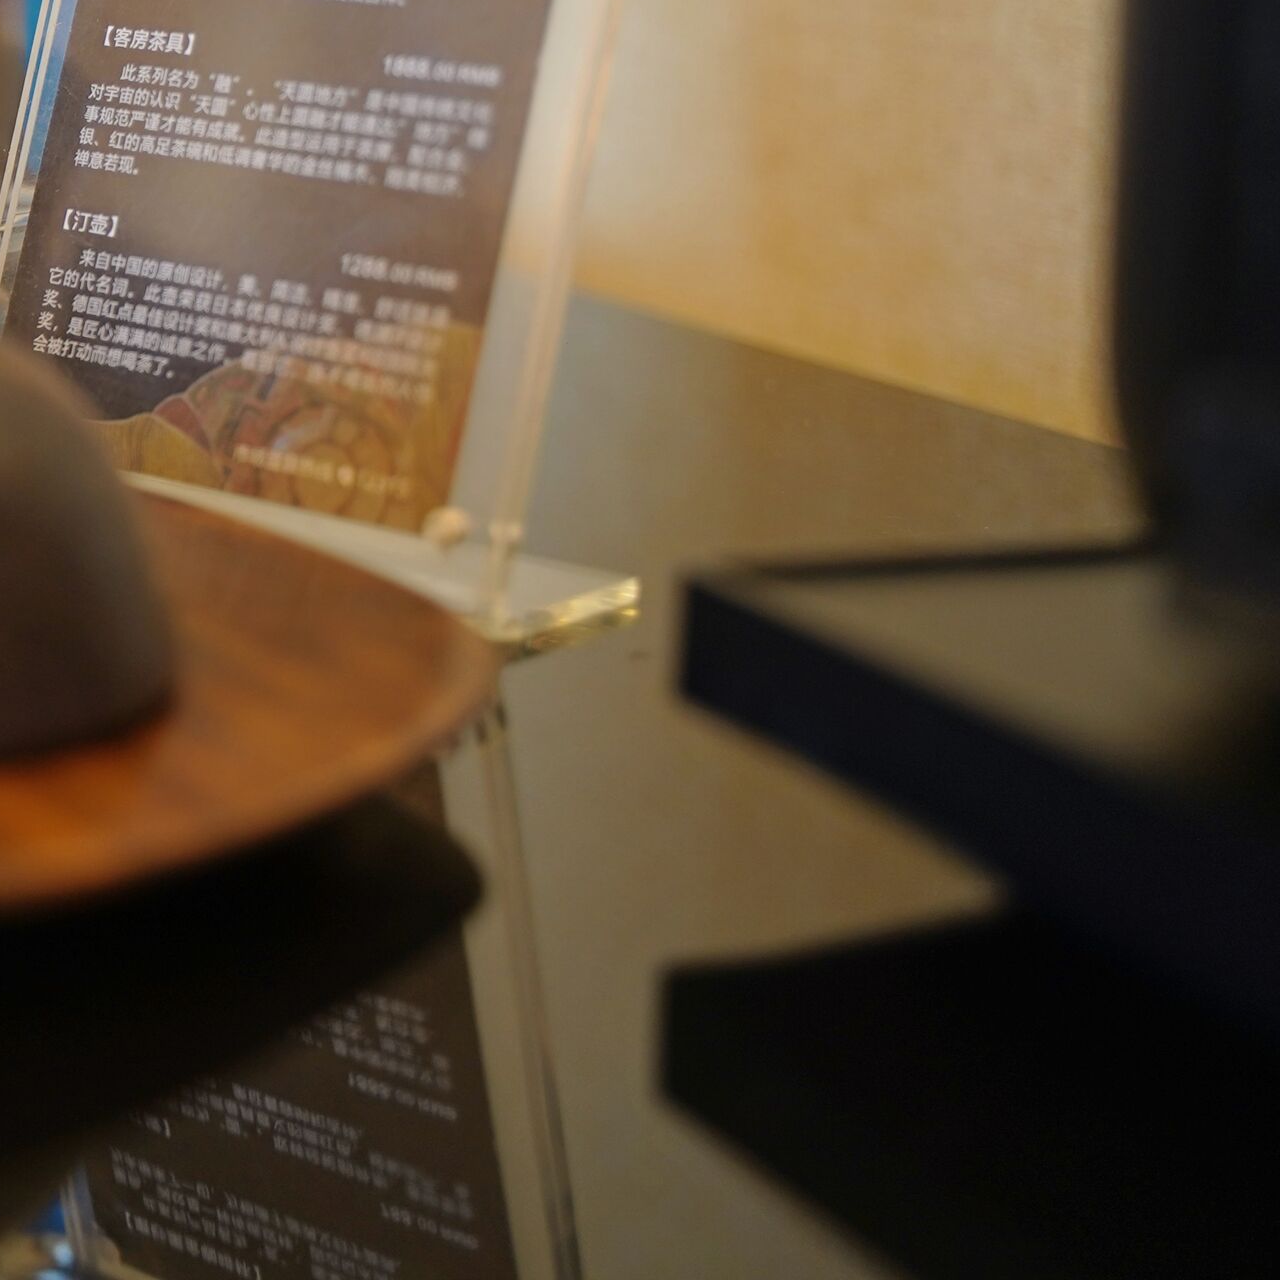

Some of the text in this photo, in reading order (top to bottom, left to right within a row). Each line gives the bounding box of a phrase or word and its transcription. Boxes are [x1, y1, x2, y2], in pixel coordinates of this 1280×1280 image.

[103, 25, 196, 56] 【客房茶具】
[74, 149, 138, 175] 禅意若现。
[32, 334, 176, 379] 会被打动而想喝茶了。
